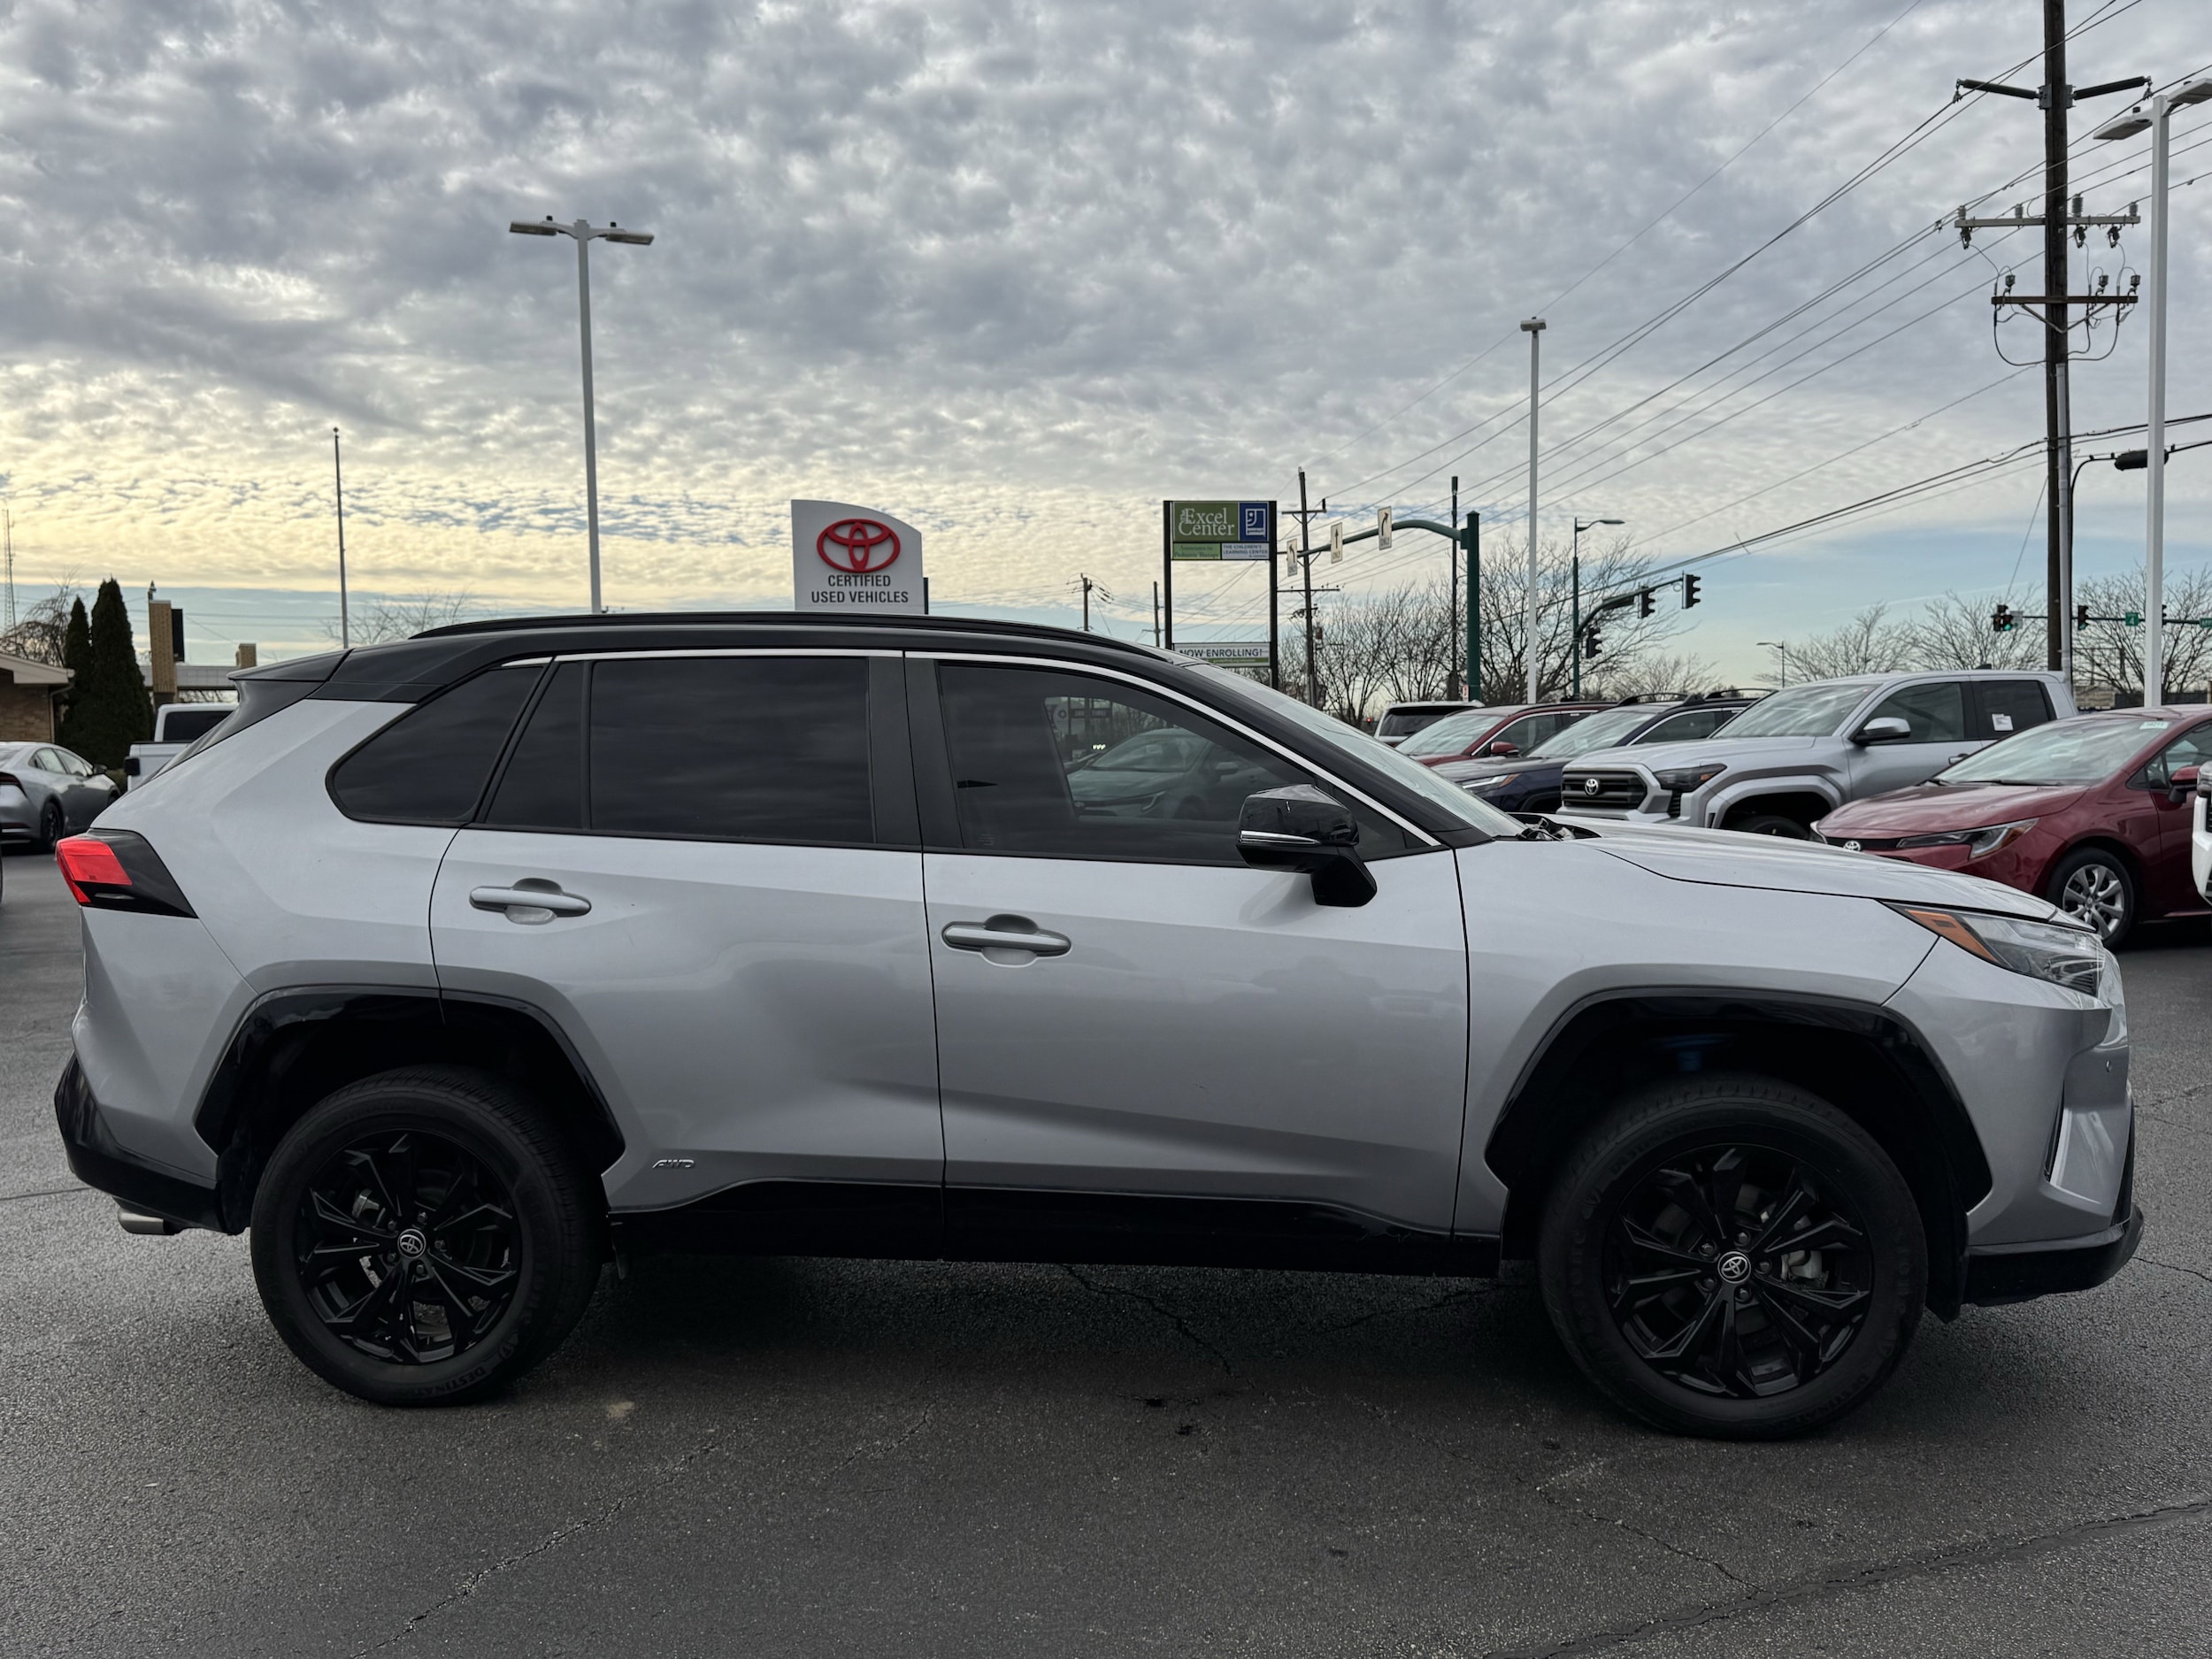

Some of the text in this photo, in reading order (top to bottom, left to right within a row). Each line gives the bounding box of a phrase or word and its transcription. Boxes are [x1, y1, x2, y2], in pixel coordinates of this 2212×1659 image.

[1185, 508, 1228, 525] Excel
[1179, 520, 1234, 536] Center
[828, 574, 891, 587] CERTIFIED
[811, 591, 909, 603] USED VEHICLES
[1206, 649, 1262, 657] ENROLLING!
